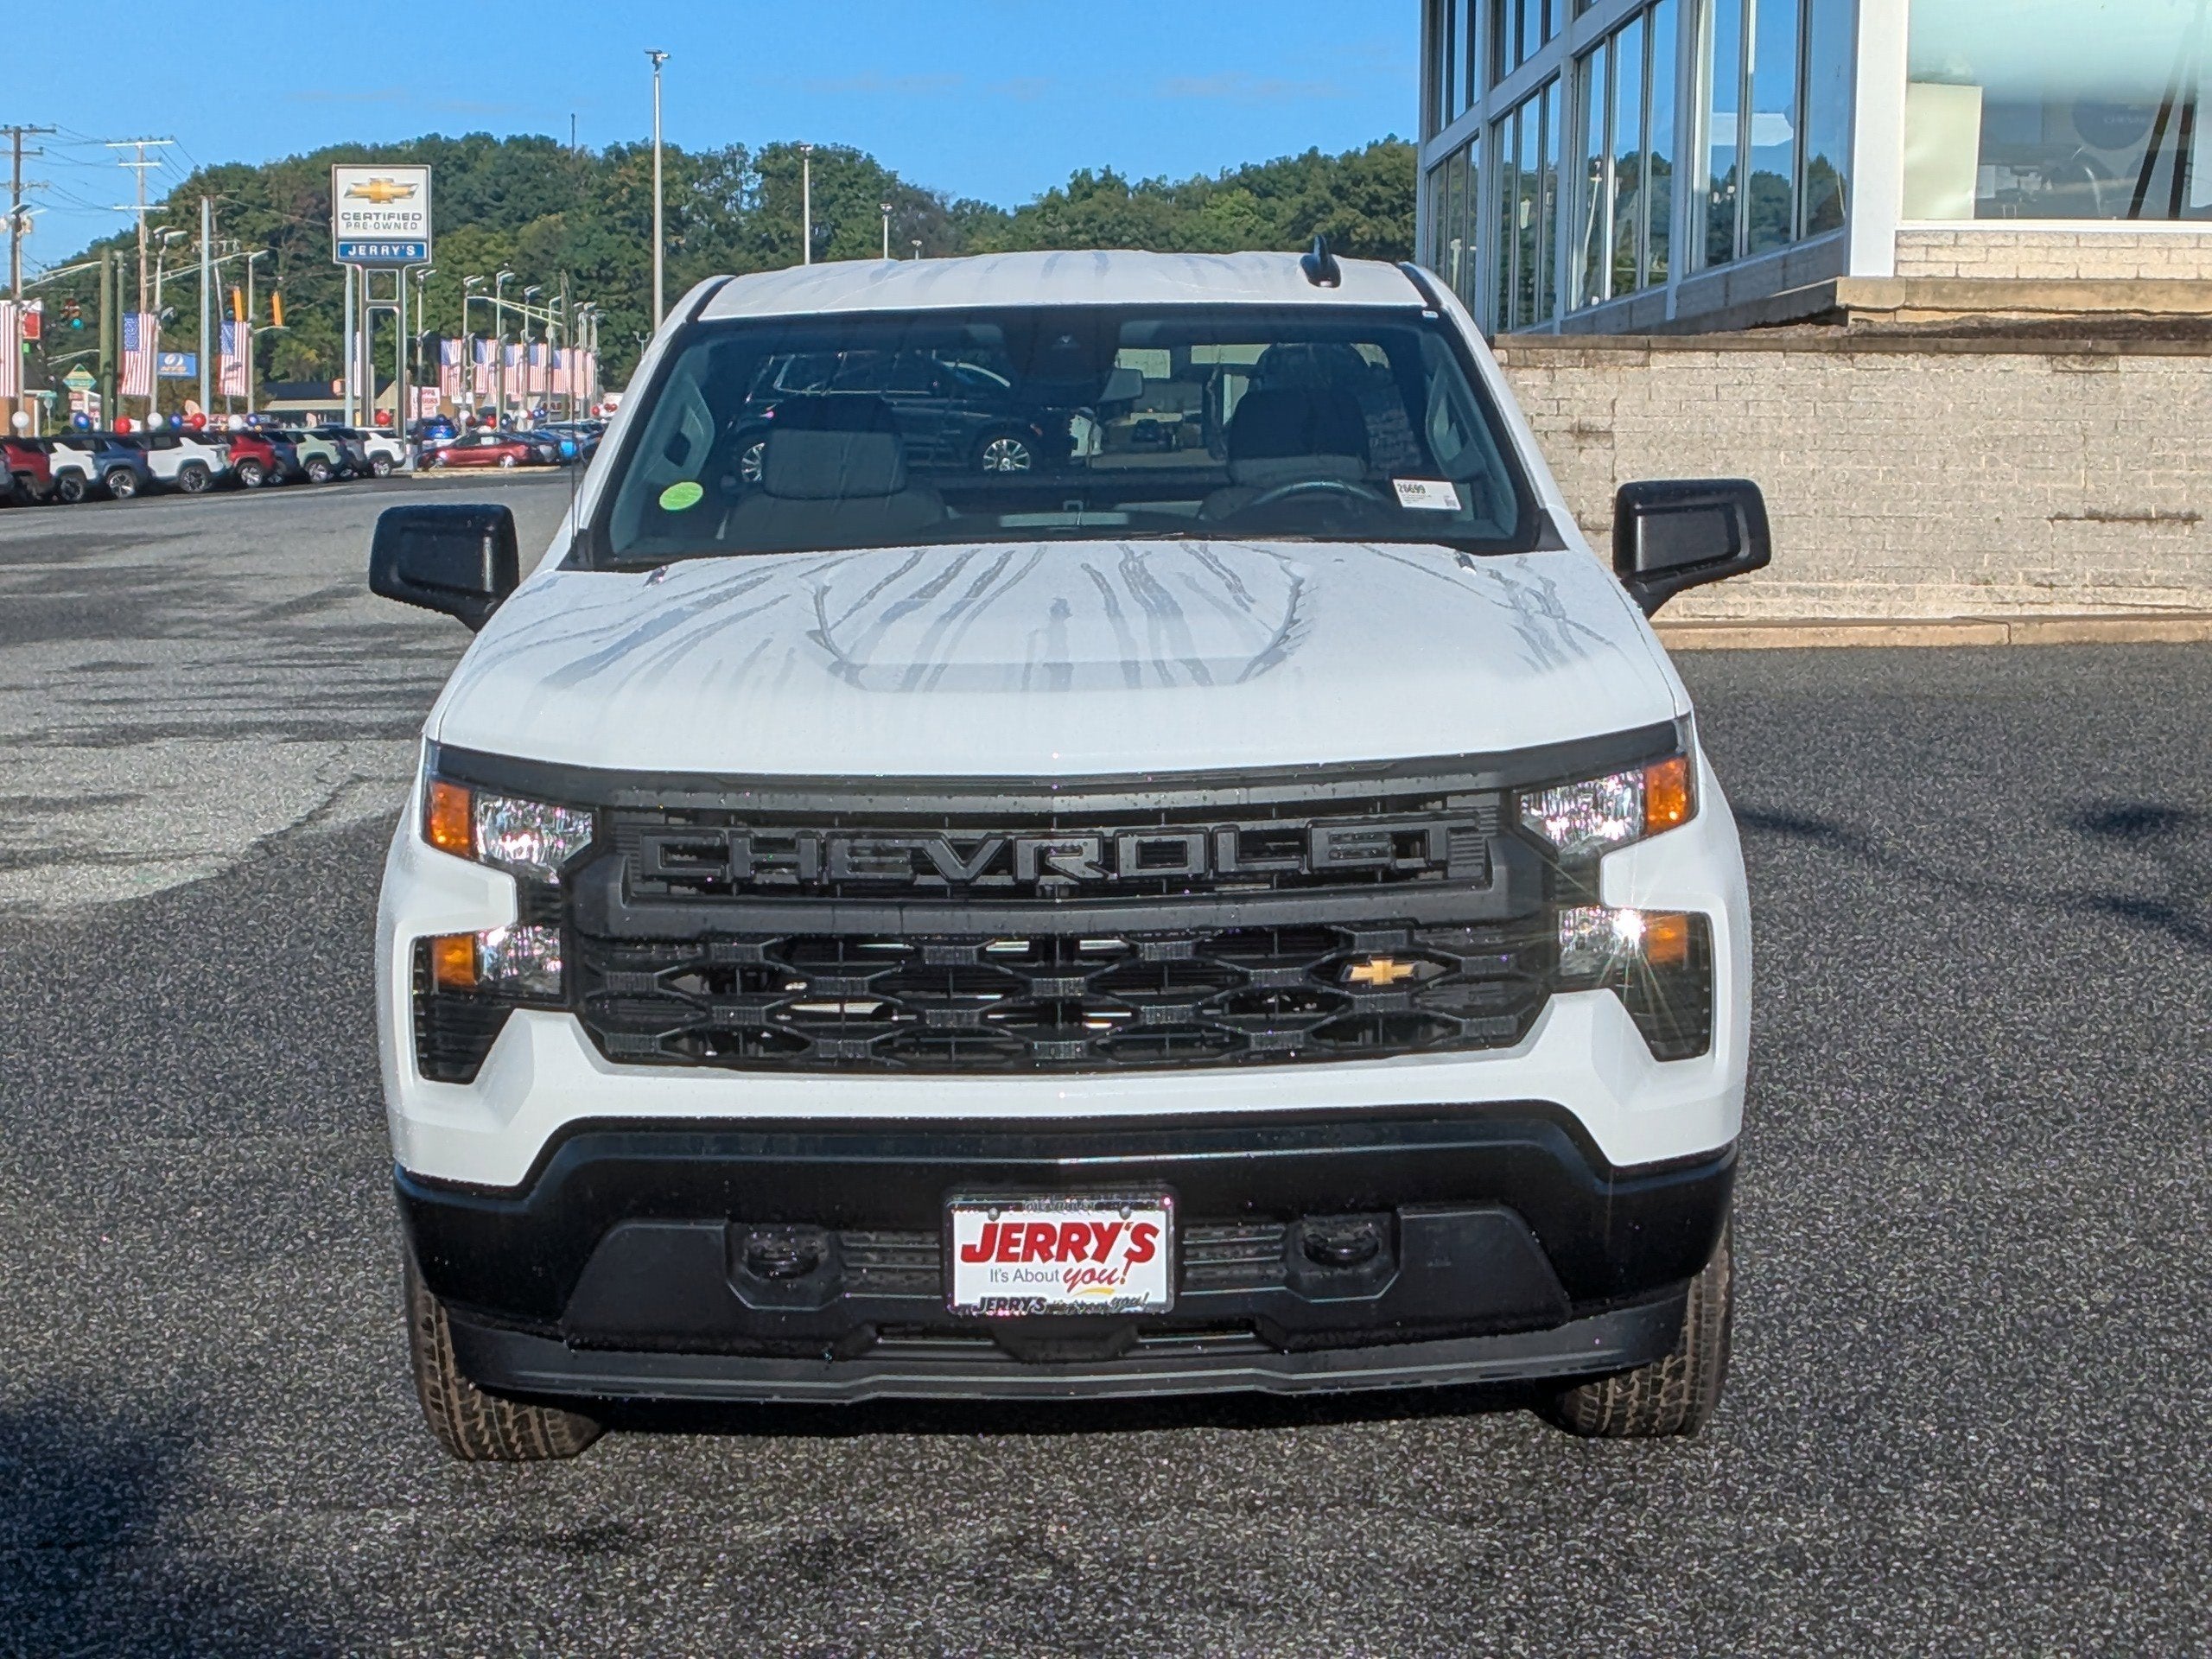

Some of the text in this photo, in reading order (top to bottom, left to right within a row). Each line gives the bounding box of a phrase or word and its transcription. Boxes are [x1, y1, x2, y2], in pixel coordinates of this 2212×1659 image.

[341, 212, 423, 221] CERTIFIED
[346, 221, 418, 230] PRE-OWNED
[347, 245, 416, 256] JERRY'S
[640, 810, 1481, 883] CHEVROLET
[960, 1221, 1160, 1264] JERRY'S
[990, 1258, 1133, 1294] It's About you!
